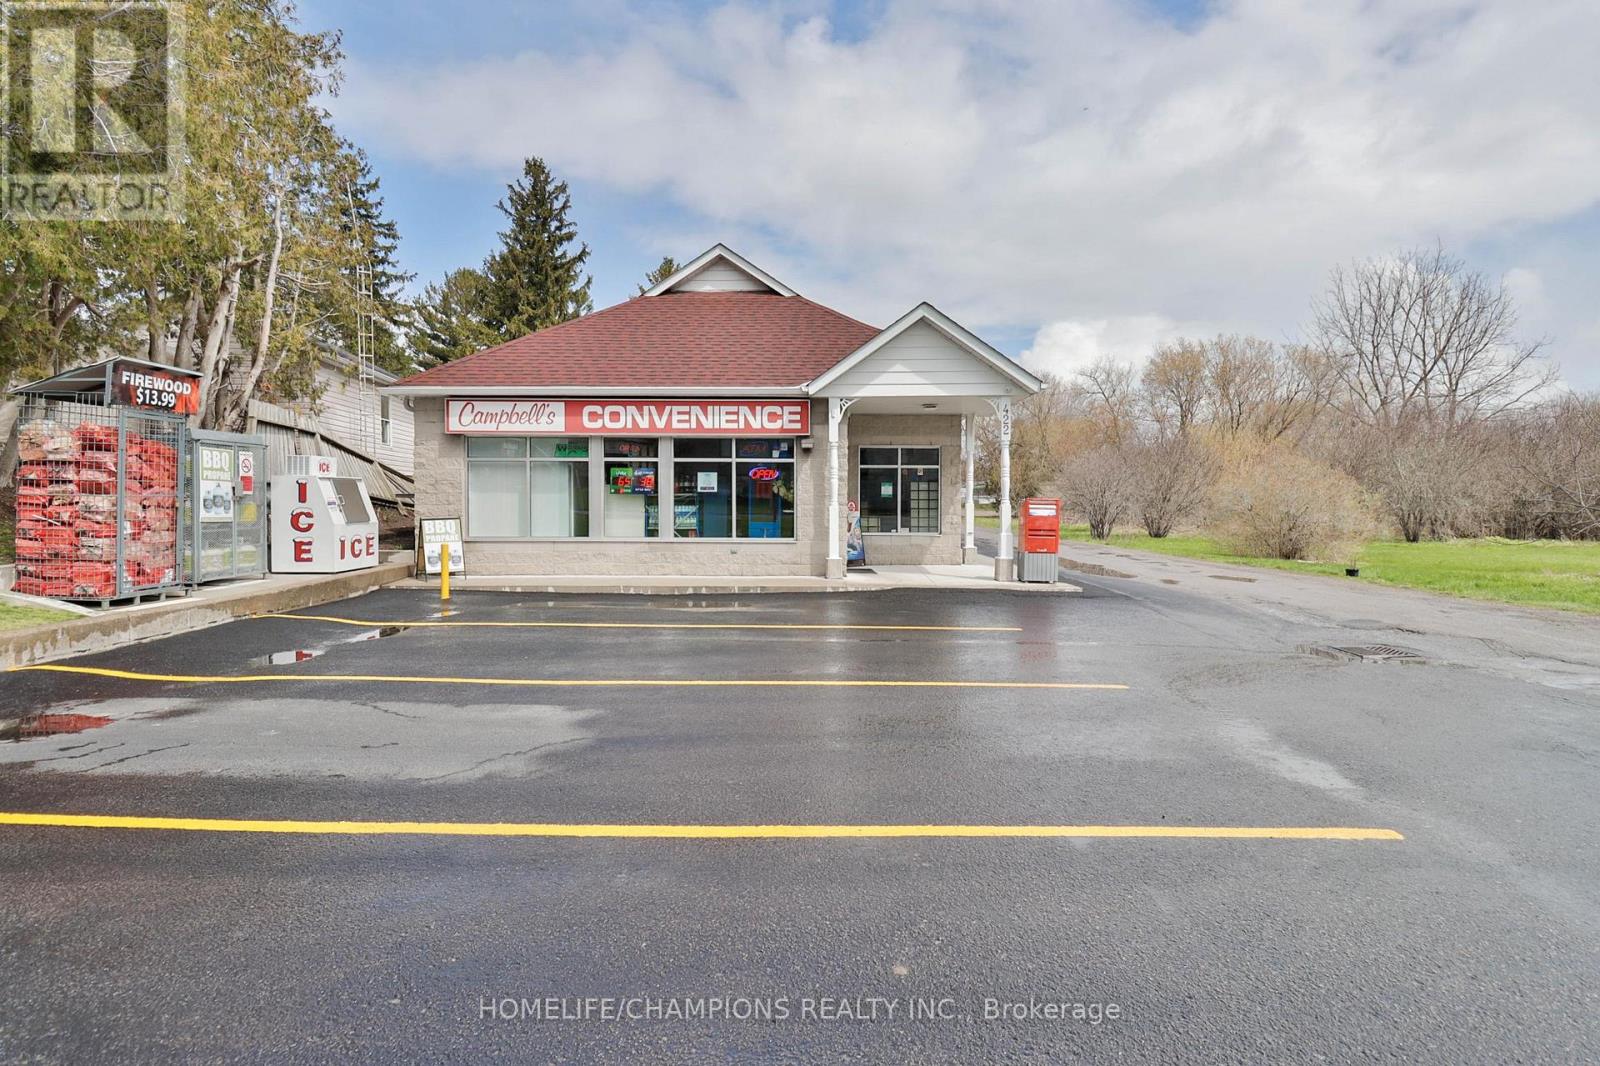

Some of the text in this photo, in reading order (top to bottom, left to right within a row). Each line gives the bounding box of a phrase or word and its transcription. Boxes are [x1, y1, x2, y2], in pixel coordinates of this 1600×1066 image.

[121, 371, 191, 395] FIREWOOD
[136, 387, 176, 407] $13.99
[458, 402, 801, 430] Campbell's CONVENIENCE
[203, 450, 229, 472] BBQ
[319, 462, 330, 472] ICE
[751, 469, 776, 480] OPEN
[290, 478, 314, 562] ICE
[423, 520, 457, 535] BBQ
[339, 534, 375, 560] ICE
